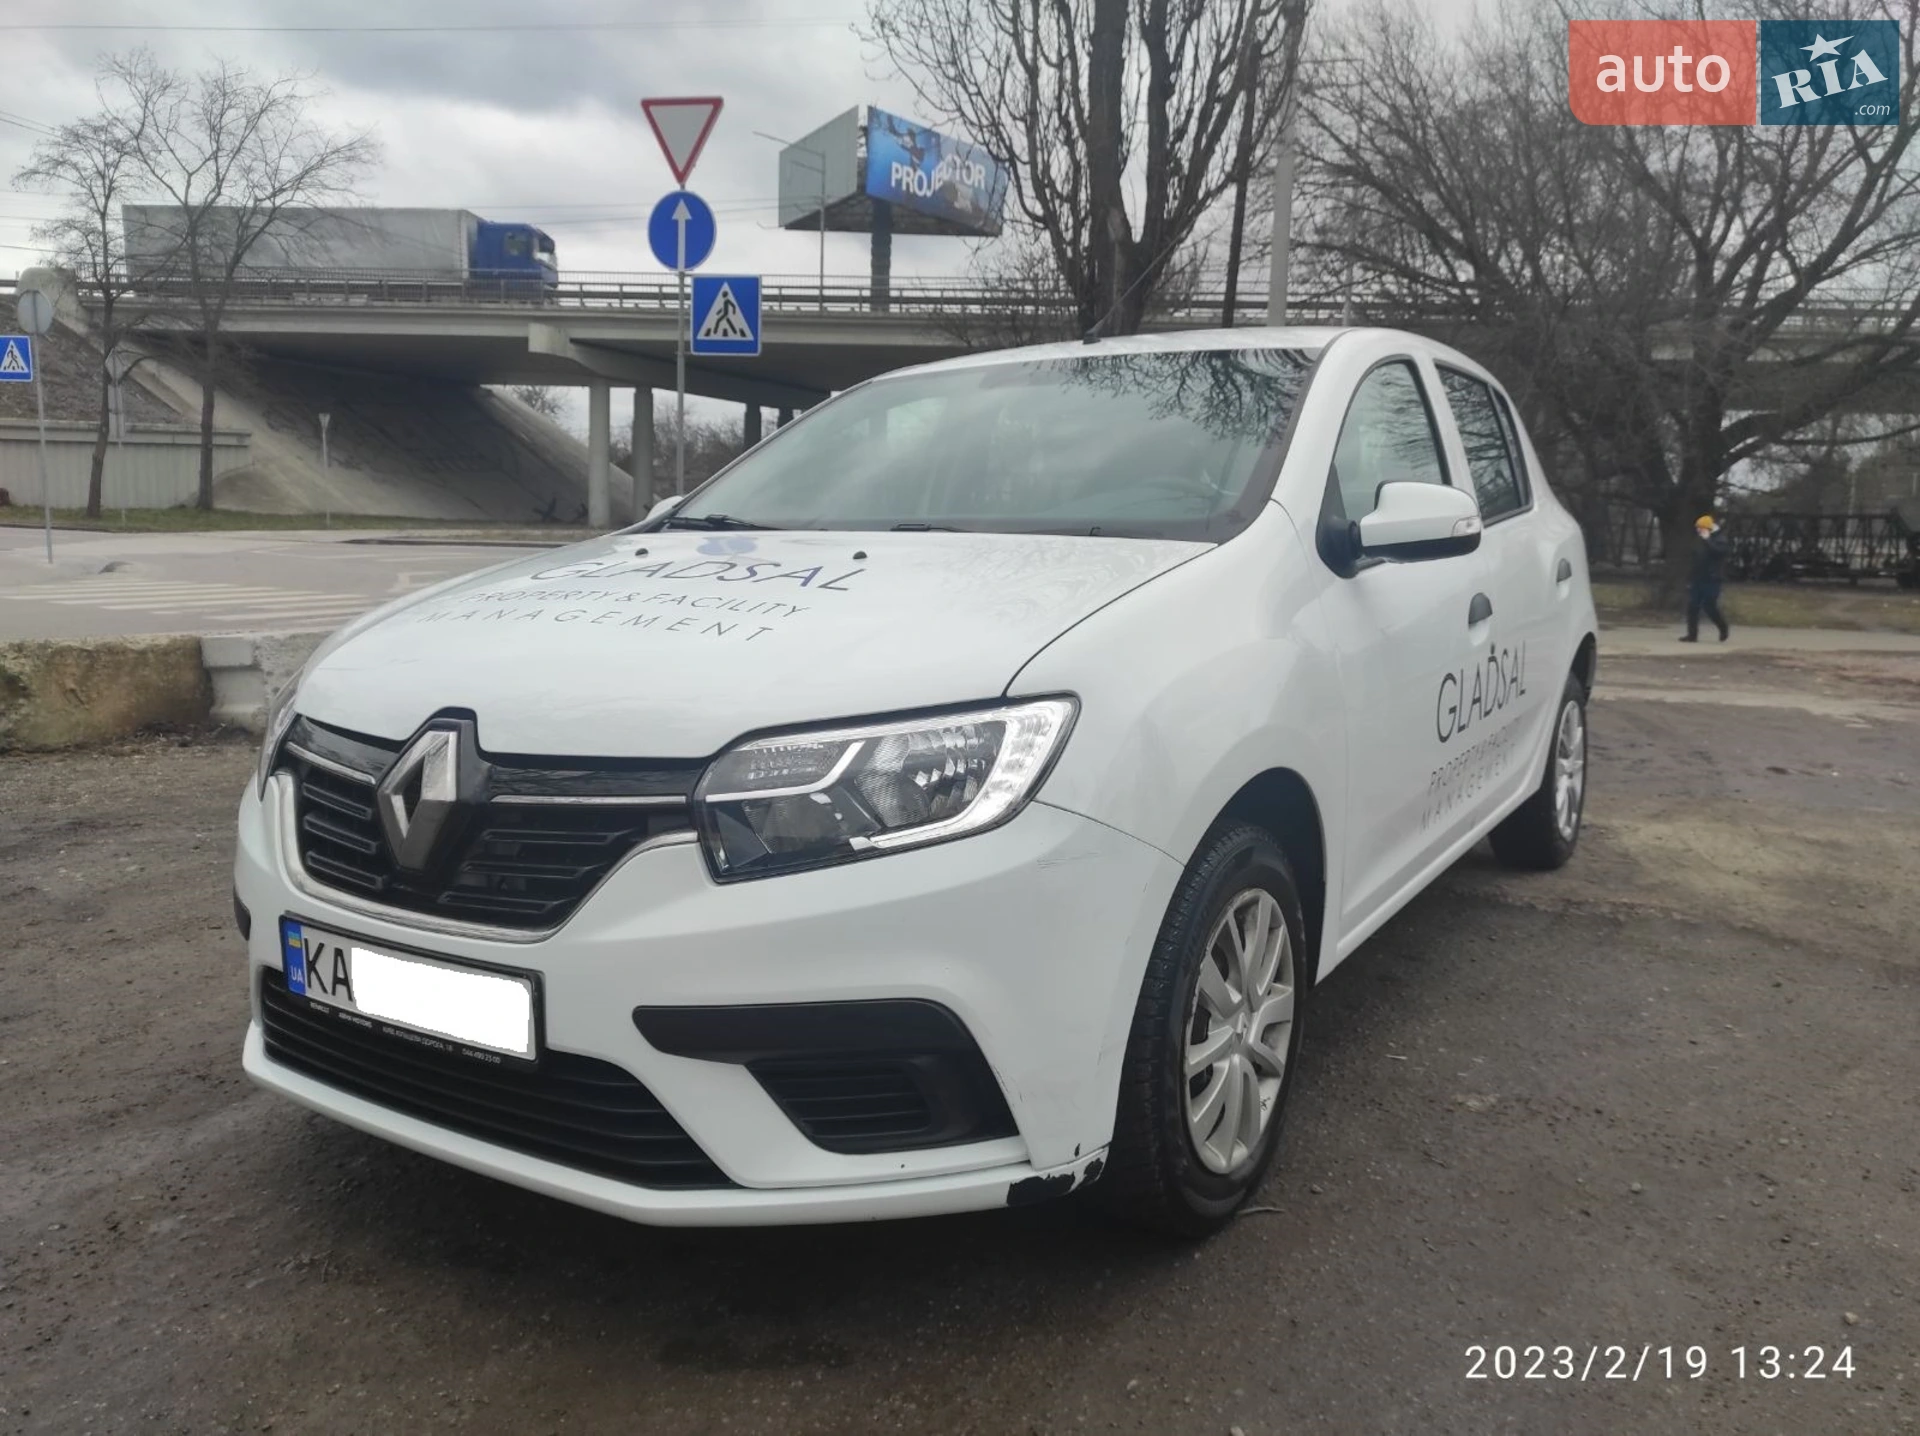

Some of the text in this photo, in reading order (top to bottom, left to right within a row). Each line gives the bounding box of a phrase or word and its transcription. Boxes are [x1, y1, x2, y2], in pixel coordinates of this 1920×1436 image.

[890, 154, 987, 198] PROJECTOR
[530, 560, 867, 591] GLADSAL
[416, 608, 774, 642] MANAGEMENT
[1436, 640, 1527, 744] GLADSAL
[291, 964, 305, 984] UA
